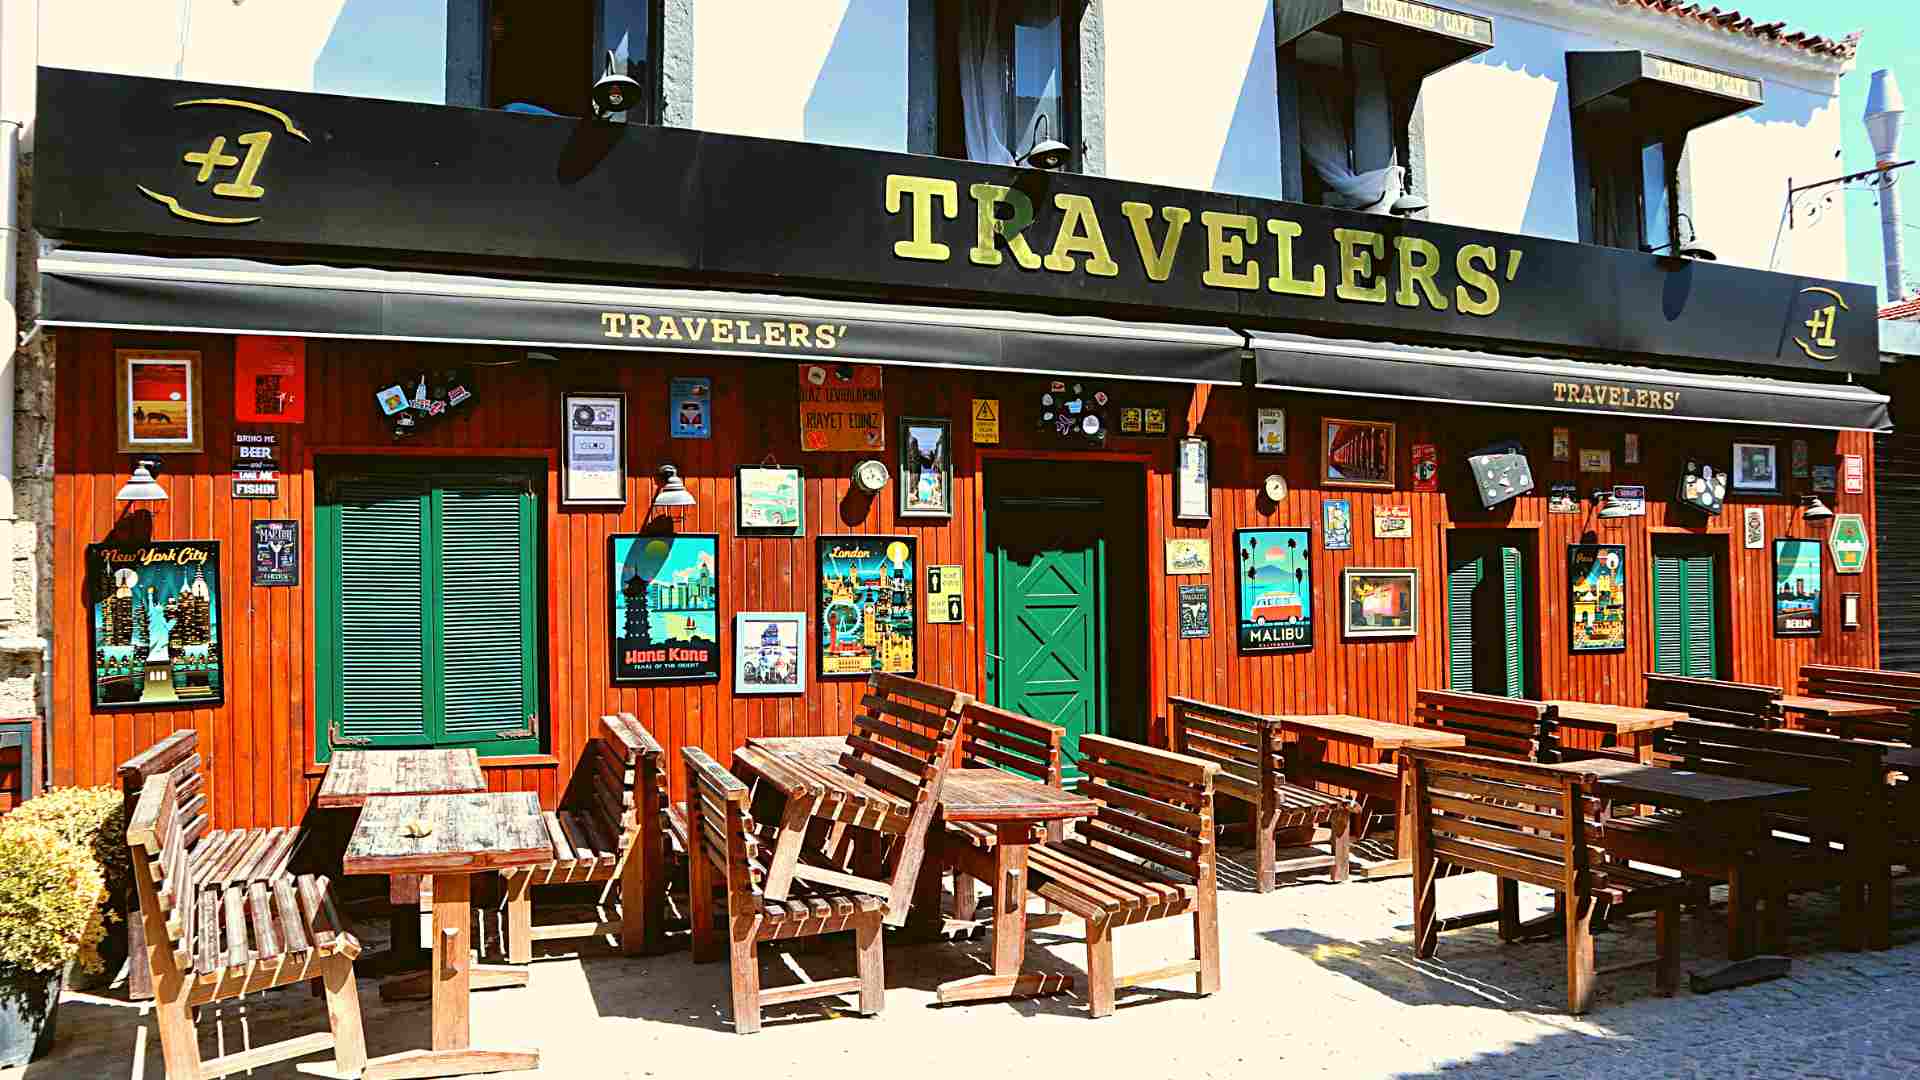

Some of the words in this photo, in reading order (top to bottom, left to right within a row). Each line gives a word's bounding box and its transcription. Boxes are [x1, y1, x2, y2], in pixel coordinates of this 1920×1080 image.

[184, 131, 272, 198] +1
[884, 174, 1522, 317] TRAVELERS'
[600, 311, 849, 350] TRAVELERS'
[1804, 305, 1836, 347] +1
[1553, 382, 1681, 410] TRAVELERS'
[239, 446, 272, 459] BEER
[236, 483, 276, 495] FISHIN
[100, 549, 136, 562] New
[137, 548, 176, 566] York
[177, 547, 208, 565] City
[831, 546, 870, 558] London
[1250, 627, 1304, 643] MALIBU
